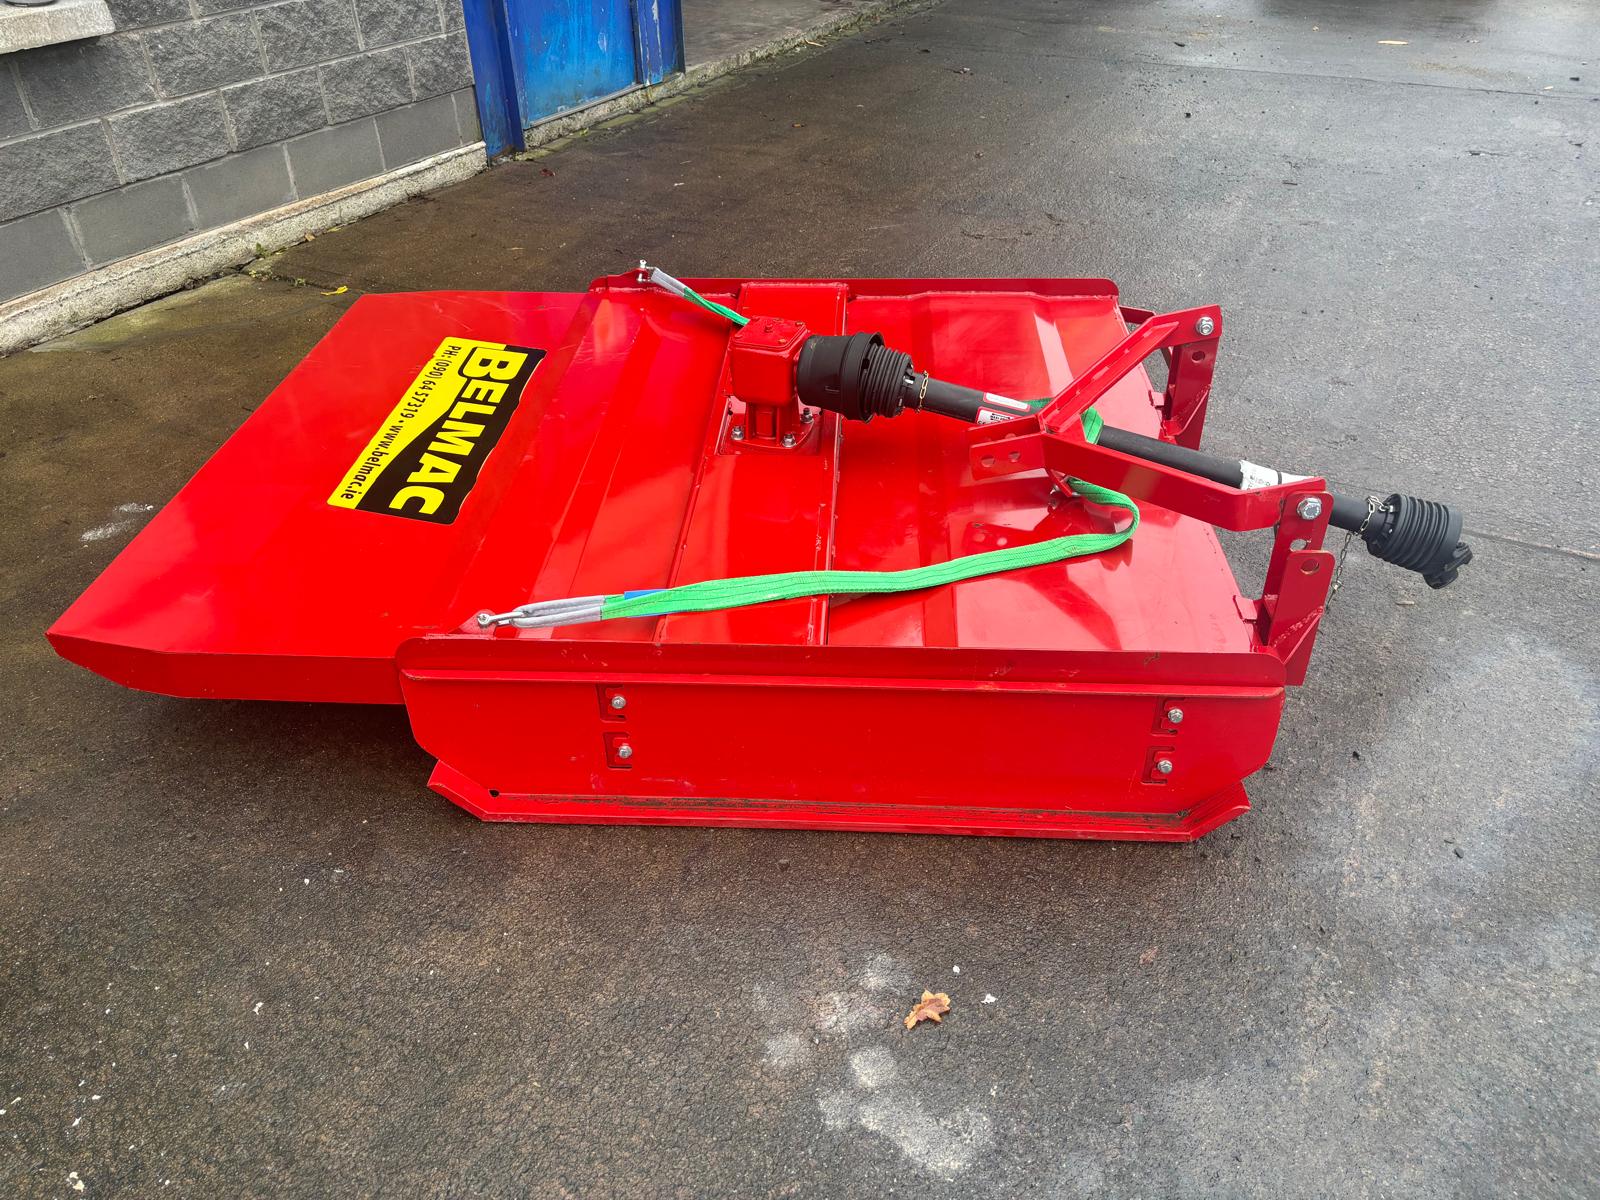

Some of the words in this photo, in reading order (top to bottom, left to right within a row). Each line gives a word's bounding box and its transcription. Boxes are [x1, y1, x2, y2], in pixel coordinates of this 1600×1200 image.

[425, 359, 452, 379] (090)
[441, 345, 462, 358] PH:
[388, 348, 529, 515] BELMAC
[340, 425, 403, 499] www.belmac.ie
